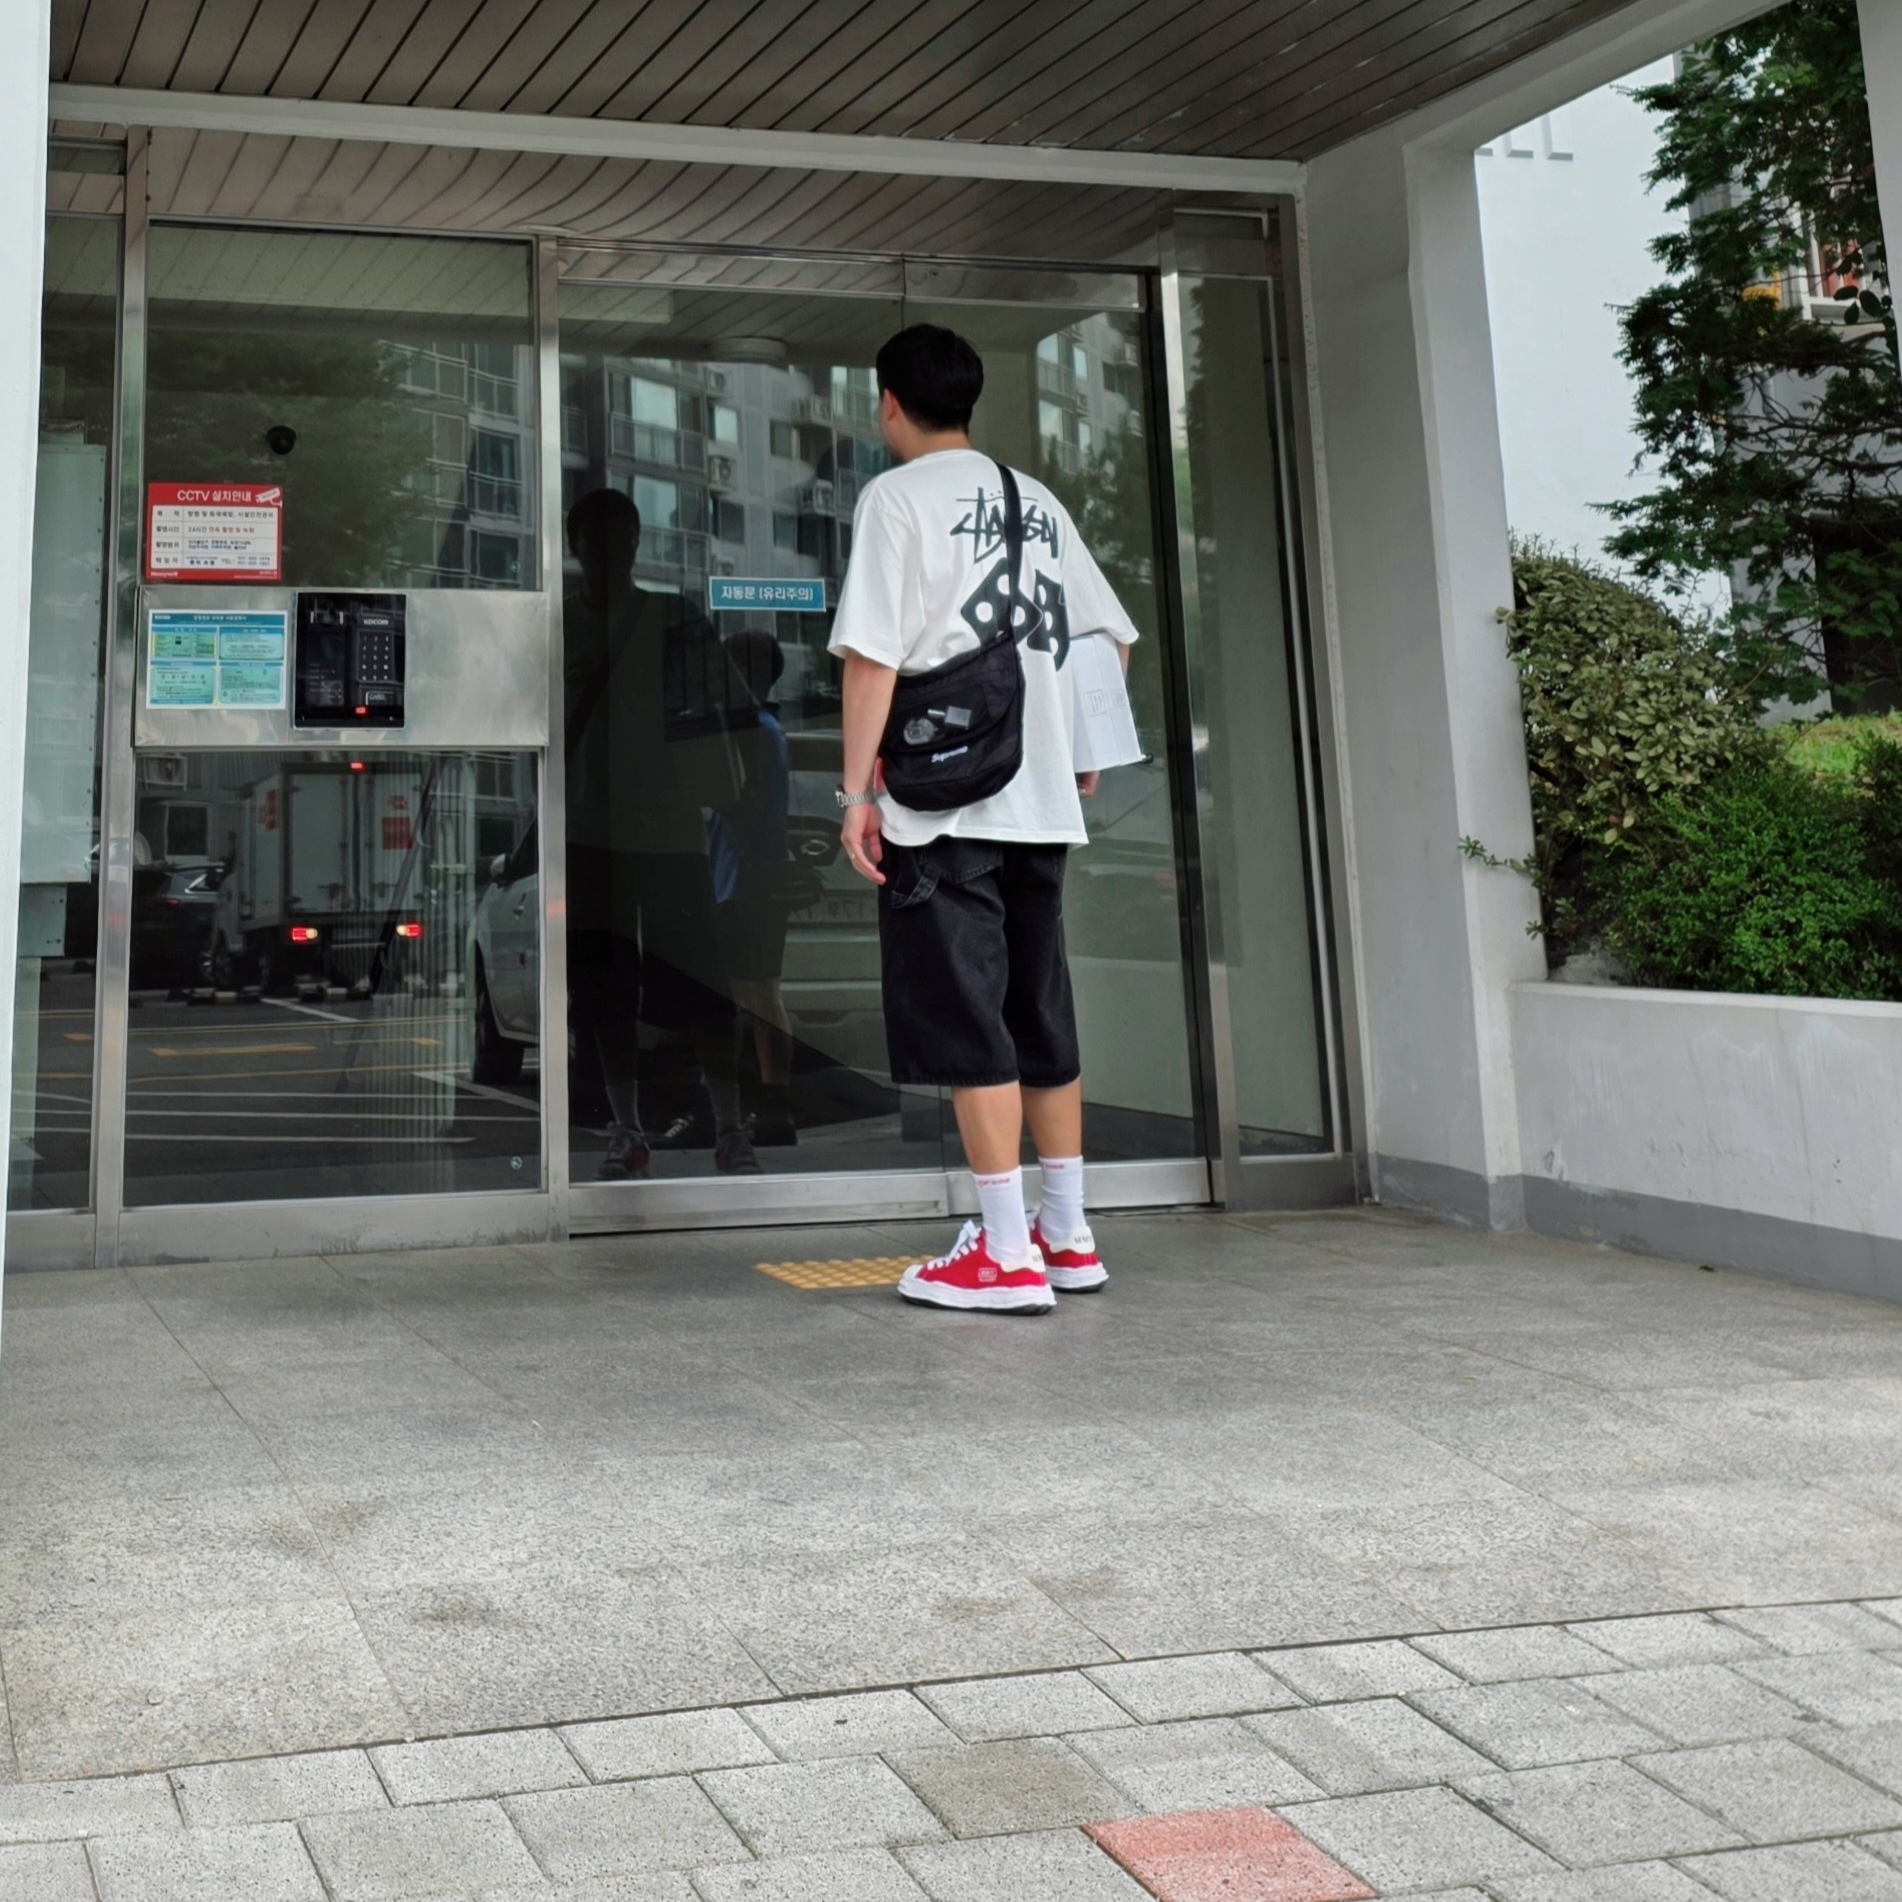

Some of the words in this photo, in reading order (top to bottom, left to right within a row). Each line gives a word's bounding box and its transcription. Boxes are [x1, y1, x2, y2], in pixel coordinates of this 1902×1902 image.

[177, 489, 210, 501] CCTV
[212, 490, 252, 502] 설치안내
[721, 585, 756, 599] 자동문
[759, 586, 814, 601] (유리주의)
[930, 745, 969, 763] Supreme
